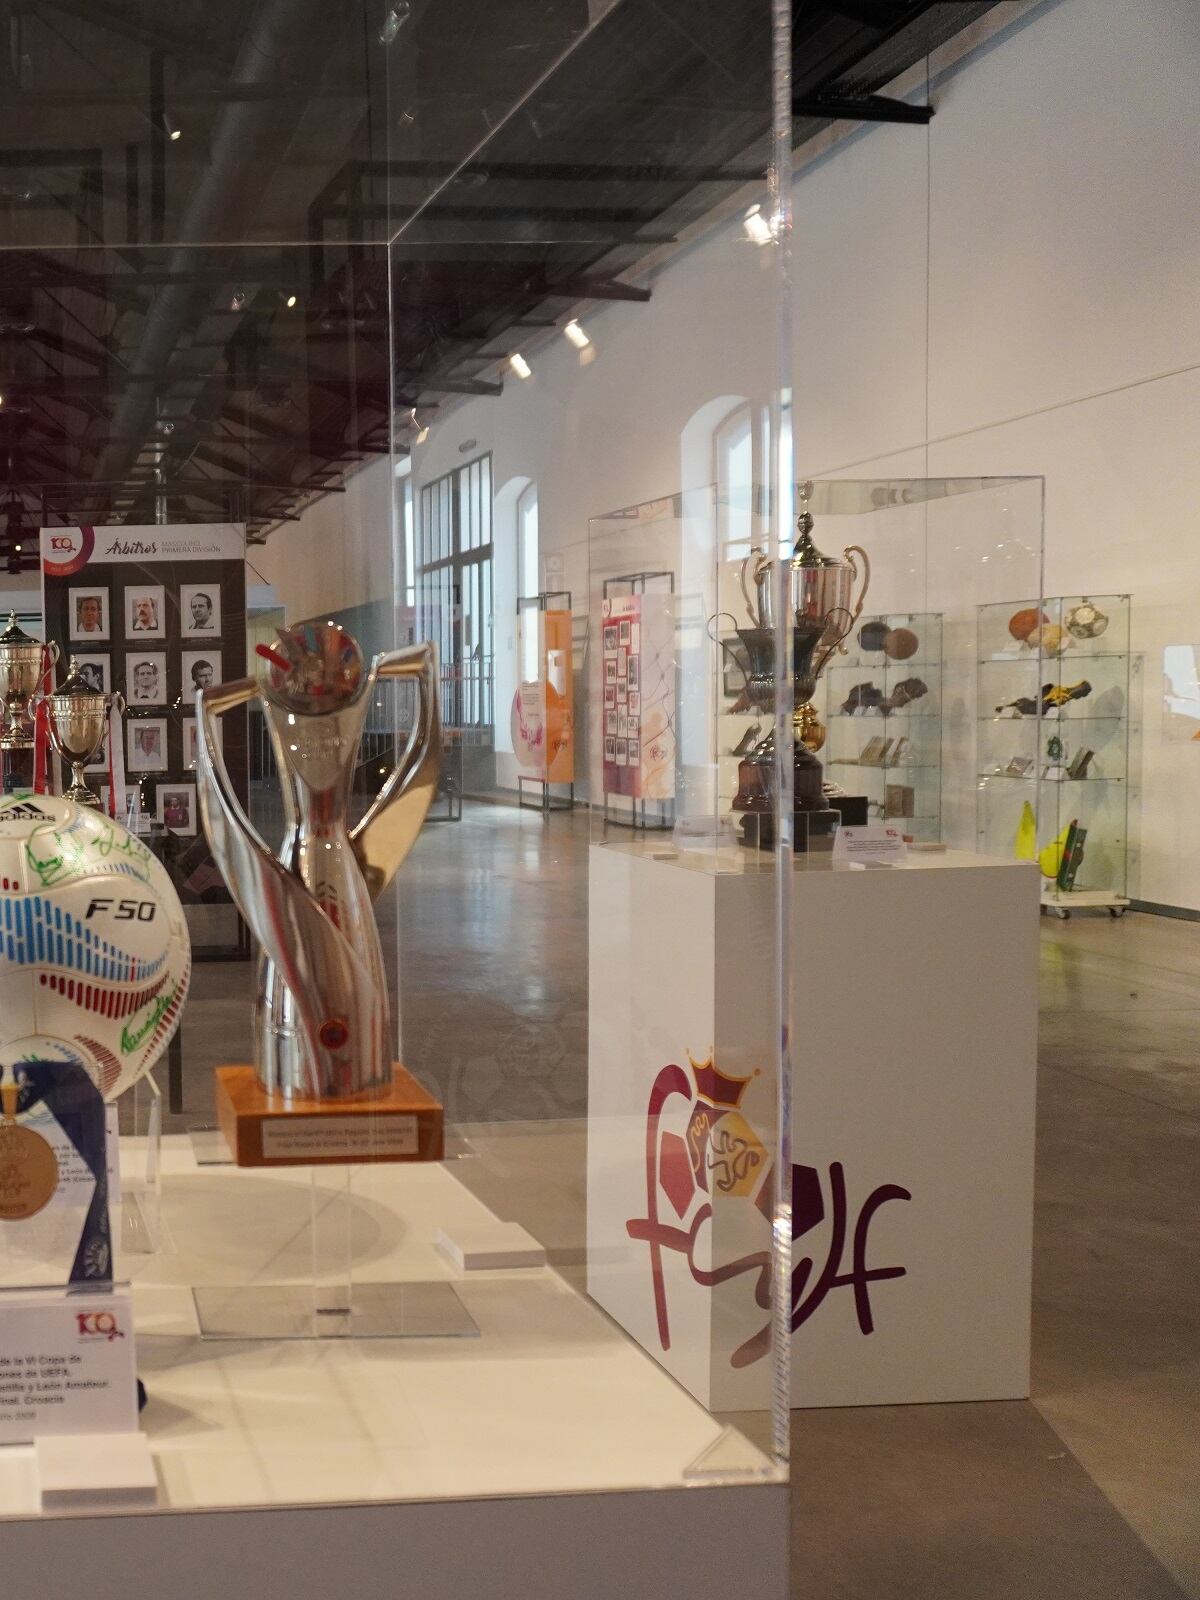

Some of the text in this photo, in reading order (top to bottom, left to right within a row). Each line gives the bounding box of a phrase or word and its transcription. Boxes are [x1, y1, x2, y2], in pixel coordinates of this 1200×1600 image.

[105, 537, 157, 555] Árbitros
[162, 544, 221, 554] PRIMERA DIVISIÓN
[0, 1357, 10, 1366] de
[38, 1355, 65, 1366] Copa
[69, 1354, 81, 1364] de
[25, 1368, 37, 1378] de
[36, 1381, 61, 1392] León
